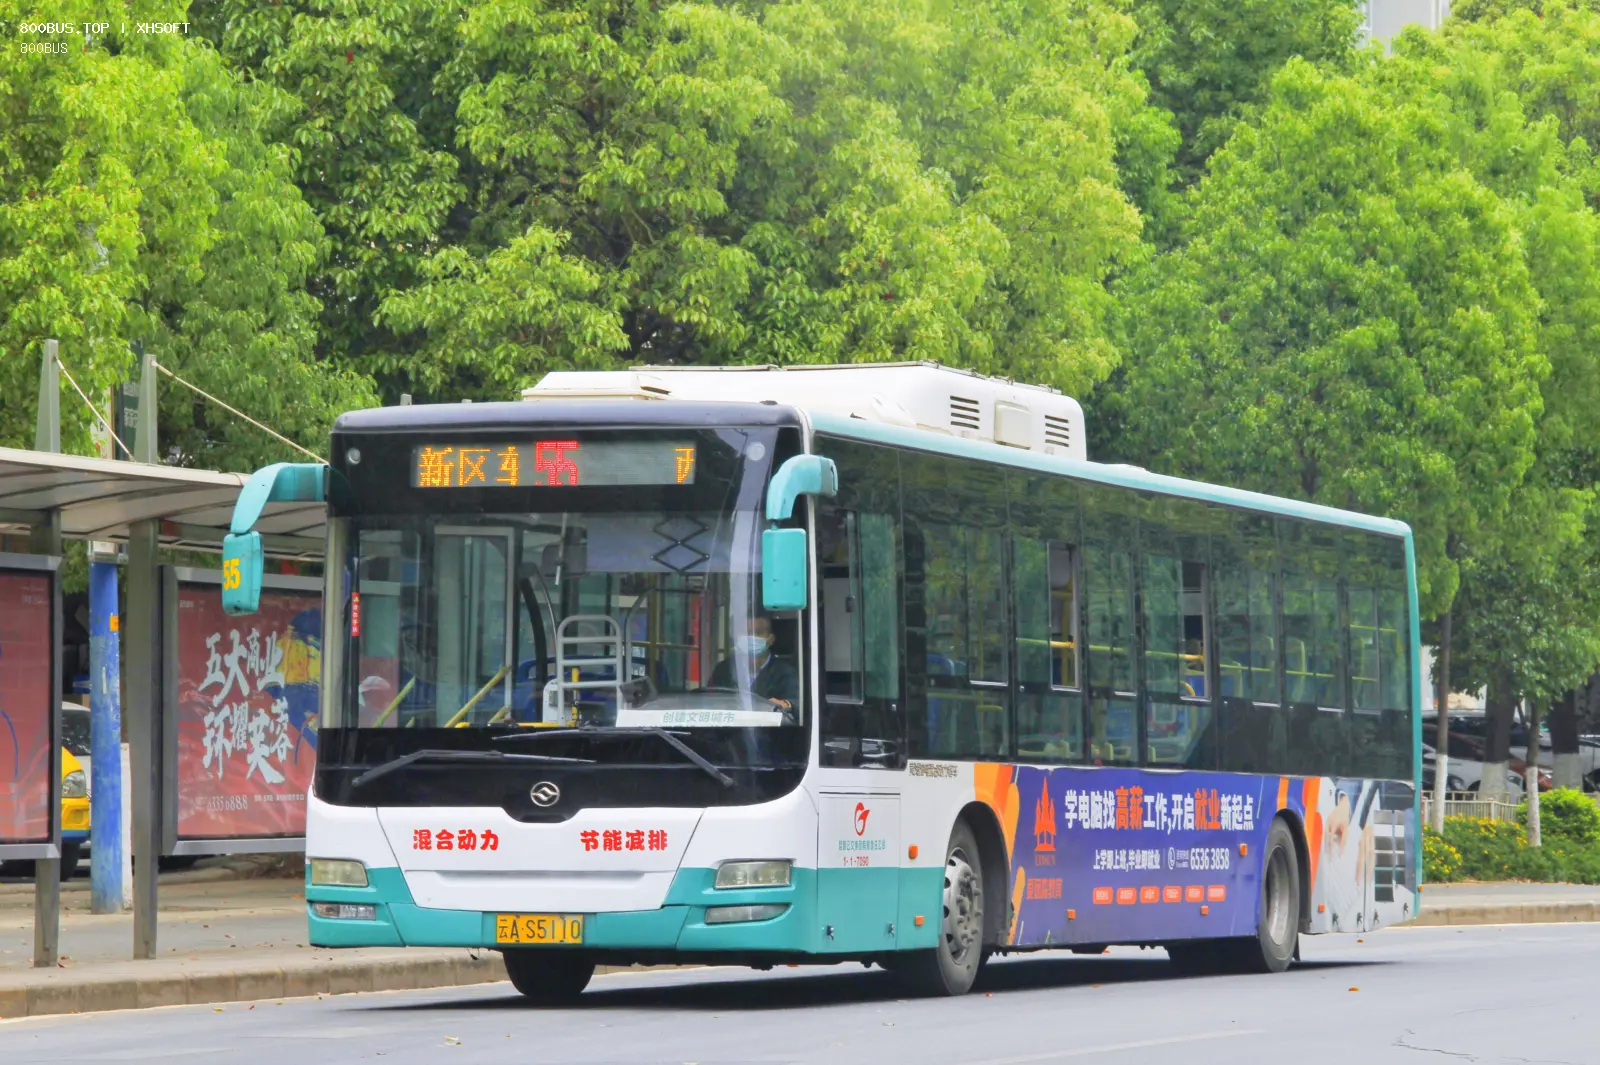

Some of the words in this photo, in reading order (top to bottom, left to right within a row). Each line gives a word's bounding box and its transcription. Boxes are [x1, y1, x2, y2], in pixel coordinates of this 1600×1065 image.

[535, 440, 580, 486] 55
[222, 558, 241, 590] 55
[198, 627, 285, 707] 五大商业
[662, 711, 736, 724] 创建文明城市
[412, 829, 499, 852] 混合动力
[580, 829, 668, 852] 节能减排
[1190, 847, 1209, 870] 6536
[1210, 847, 1230, 870] 3858
